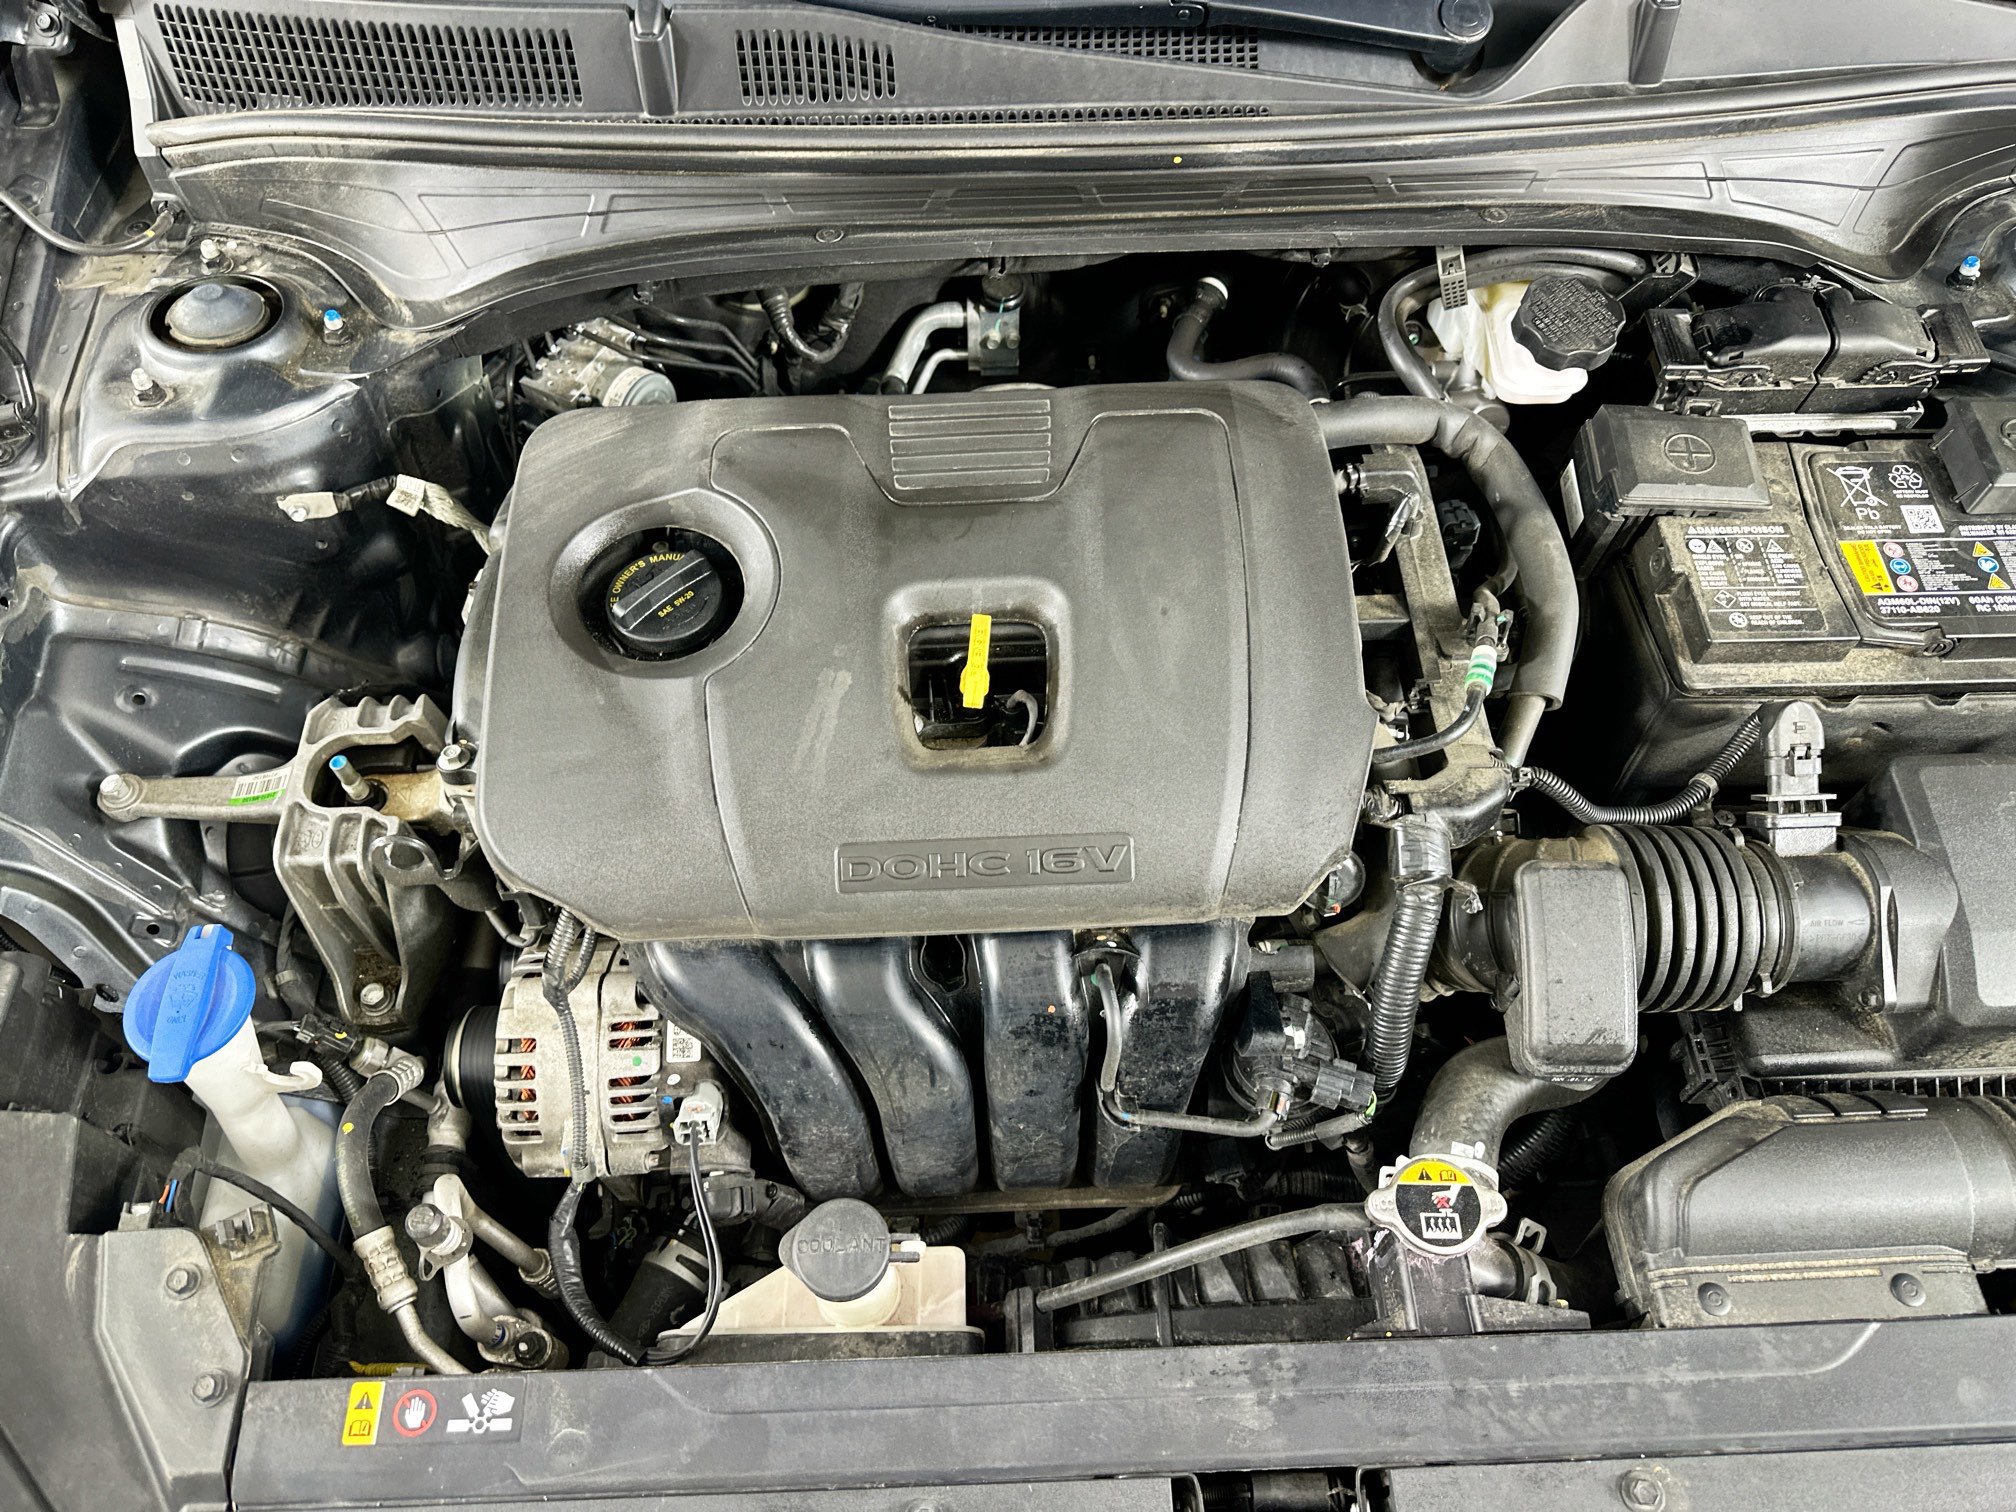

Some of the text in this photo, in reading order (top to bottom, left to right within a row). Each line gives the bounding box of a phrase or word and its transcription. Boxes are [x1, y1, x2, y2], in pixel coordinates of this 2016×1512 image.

[1855, 507, 1880, 520] Pb
[1696, 525, 1785, 534] DANGER/POISON
[612, 560, 646, 594] OWNER'S
[657, 605, 674, 618] SAE
[1975, 604, 1992, 612] RC
[840, 844, 1128, 883] DOHC 16V
[1810, 919, 1844, 927] AIR FLOW
[797, 1236, 887, 1255] COOLANT
